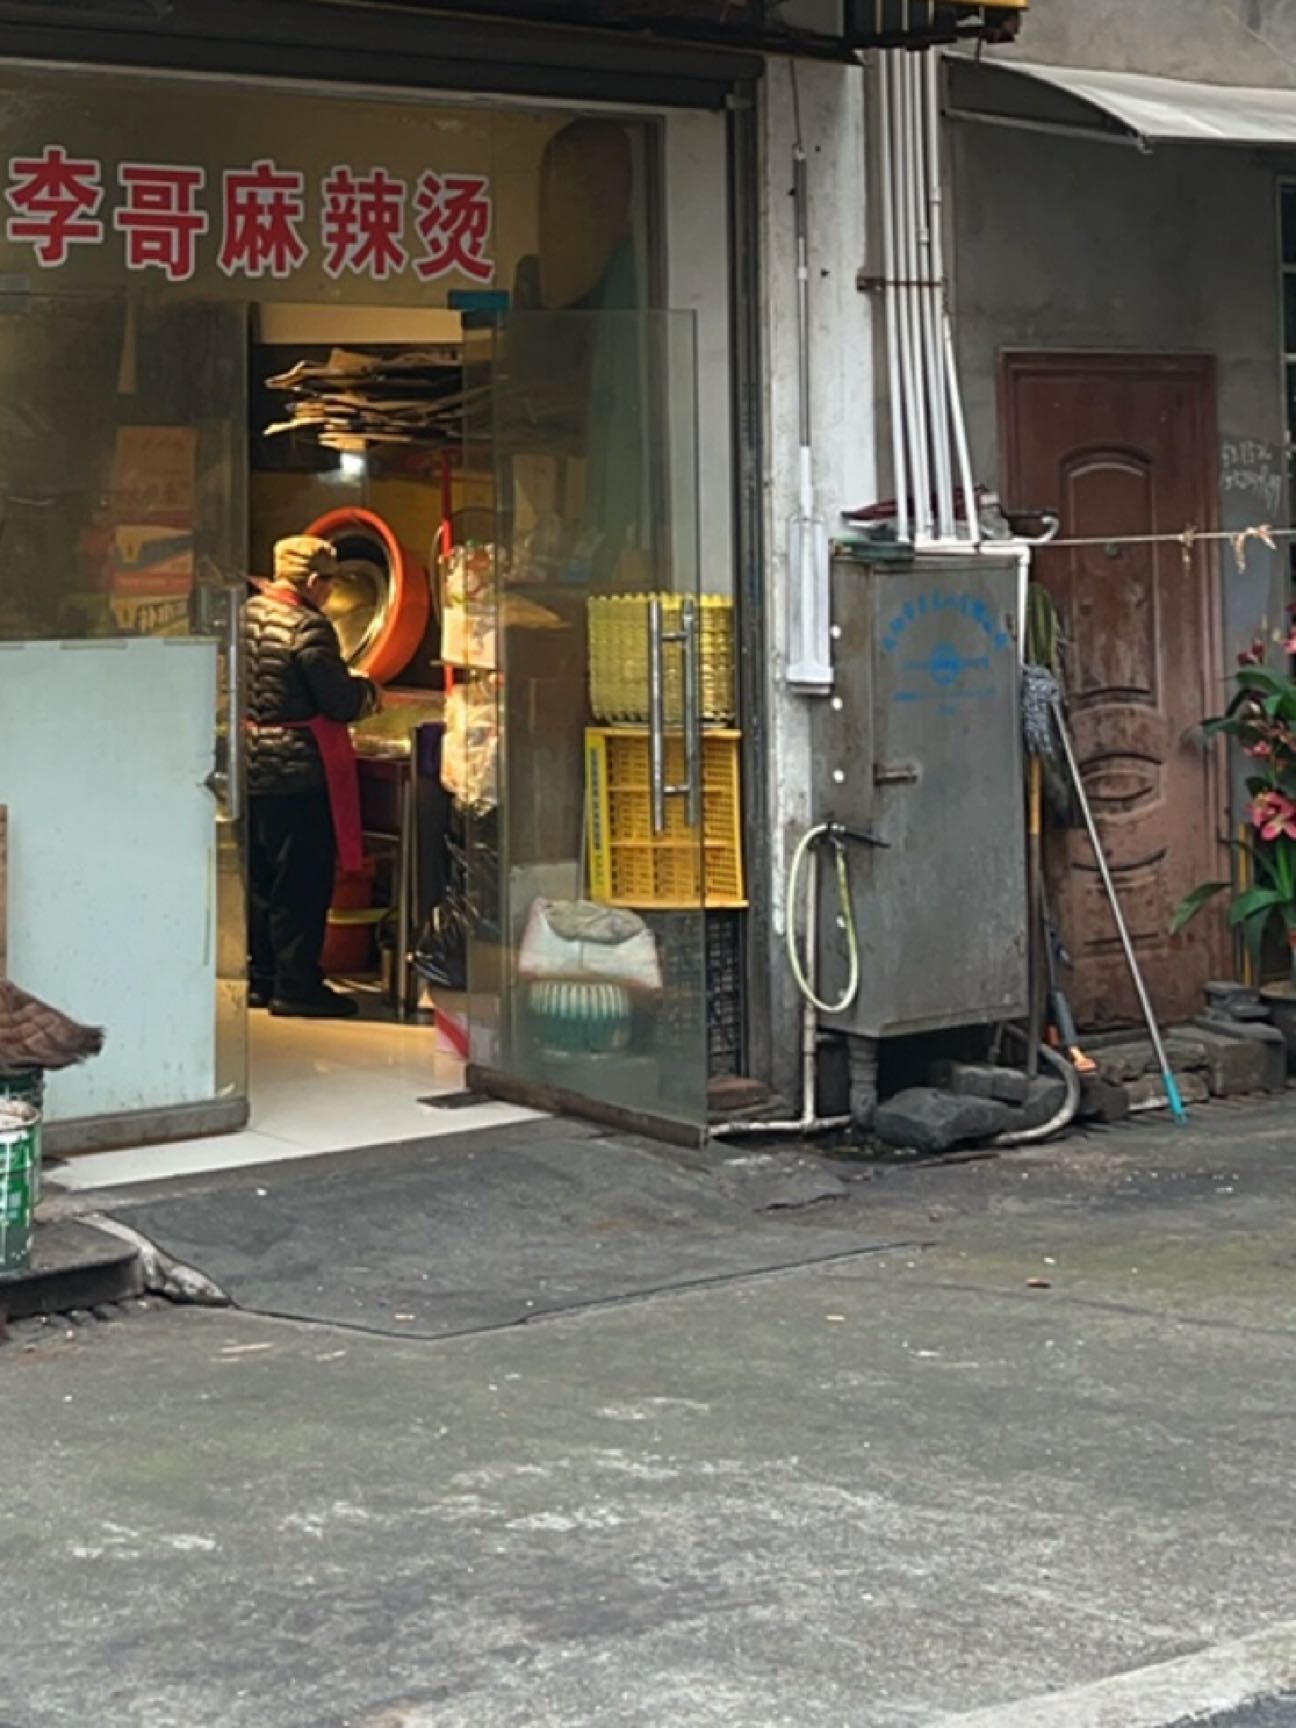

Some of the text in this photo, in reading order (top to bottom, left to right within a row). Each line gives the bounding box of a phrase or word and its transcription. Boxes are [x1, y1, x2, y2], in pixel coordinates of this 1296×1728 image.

[5, 145, 495, 283] 李哥麻辣烫
